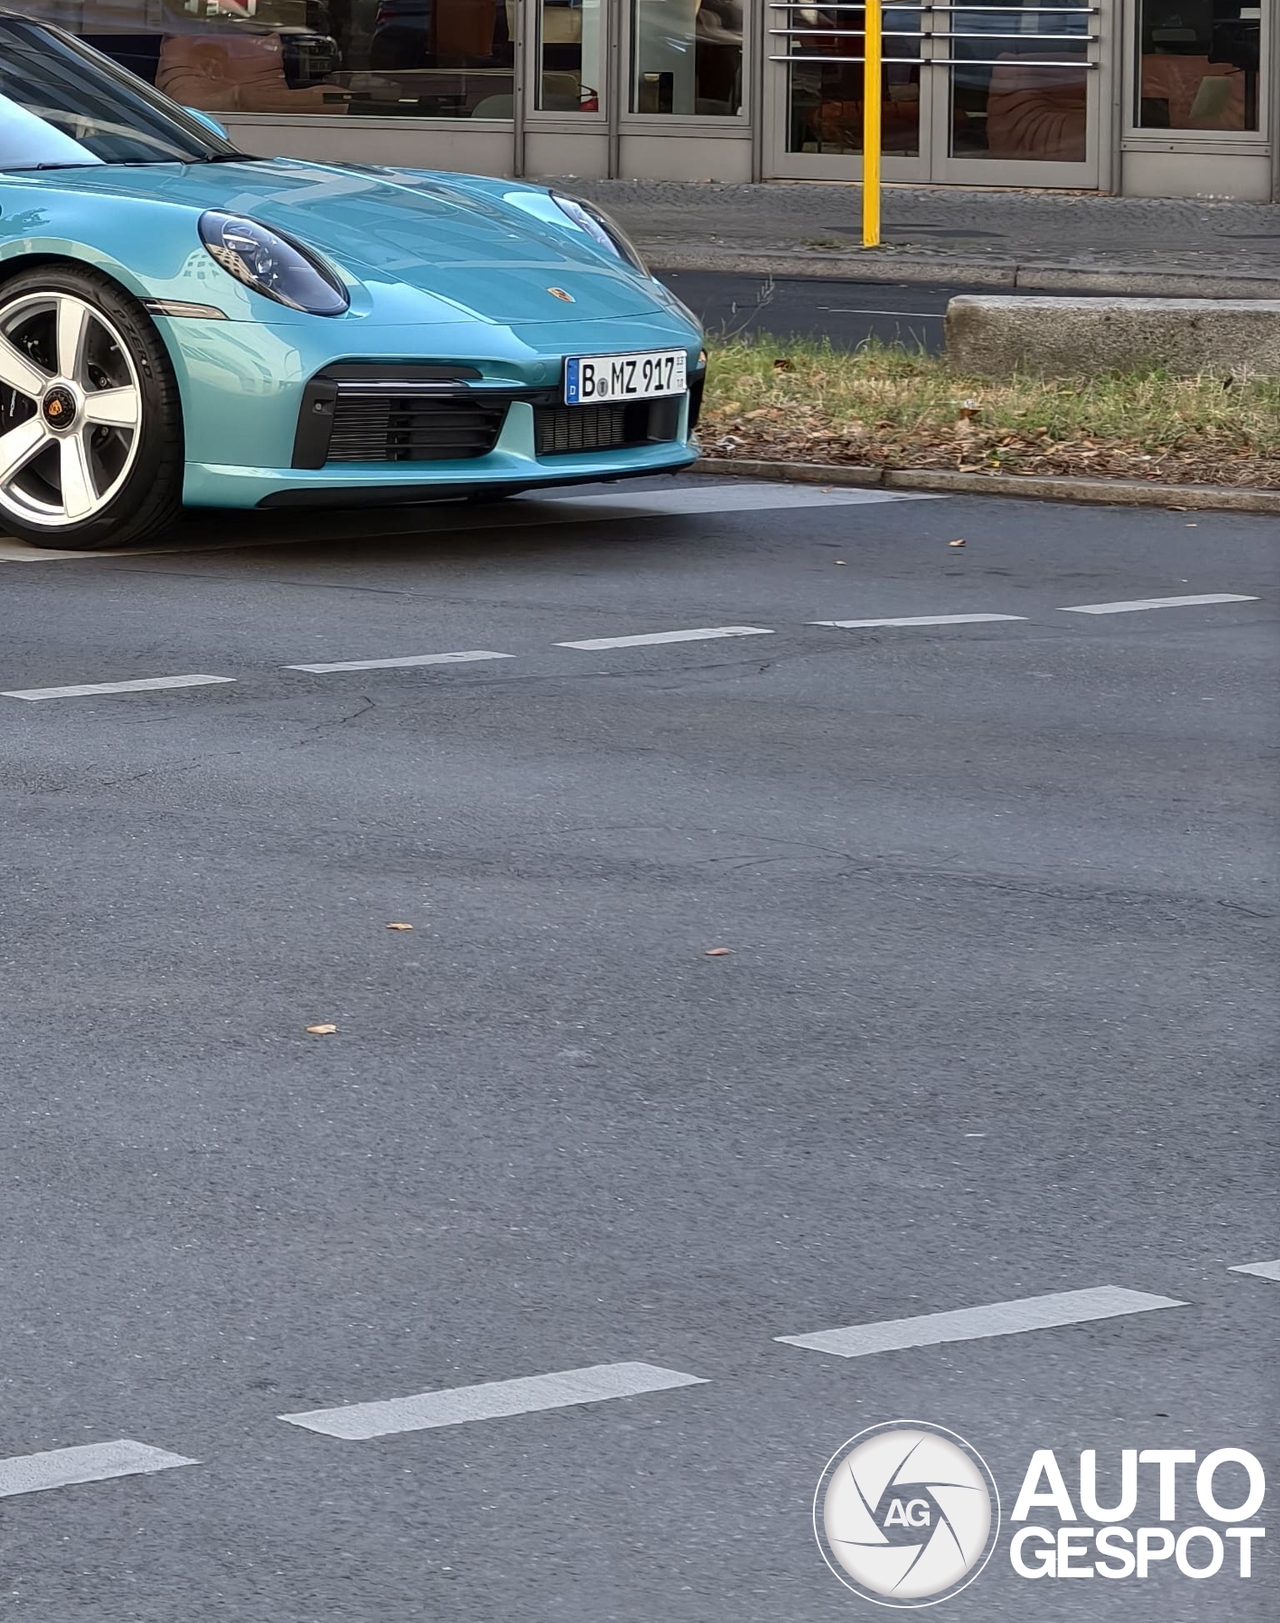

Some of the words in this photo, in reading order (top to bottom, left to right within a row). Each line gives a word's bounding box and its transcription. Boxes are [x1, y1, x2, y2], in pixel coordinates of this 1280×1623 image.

[582, 364, 595, 397] B
[611, 360, 638, 395] MZ
[642, 357, 675, 393] 917
